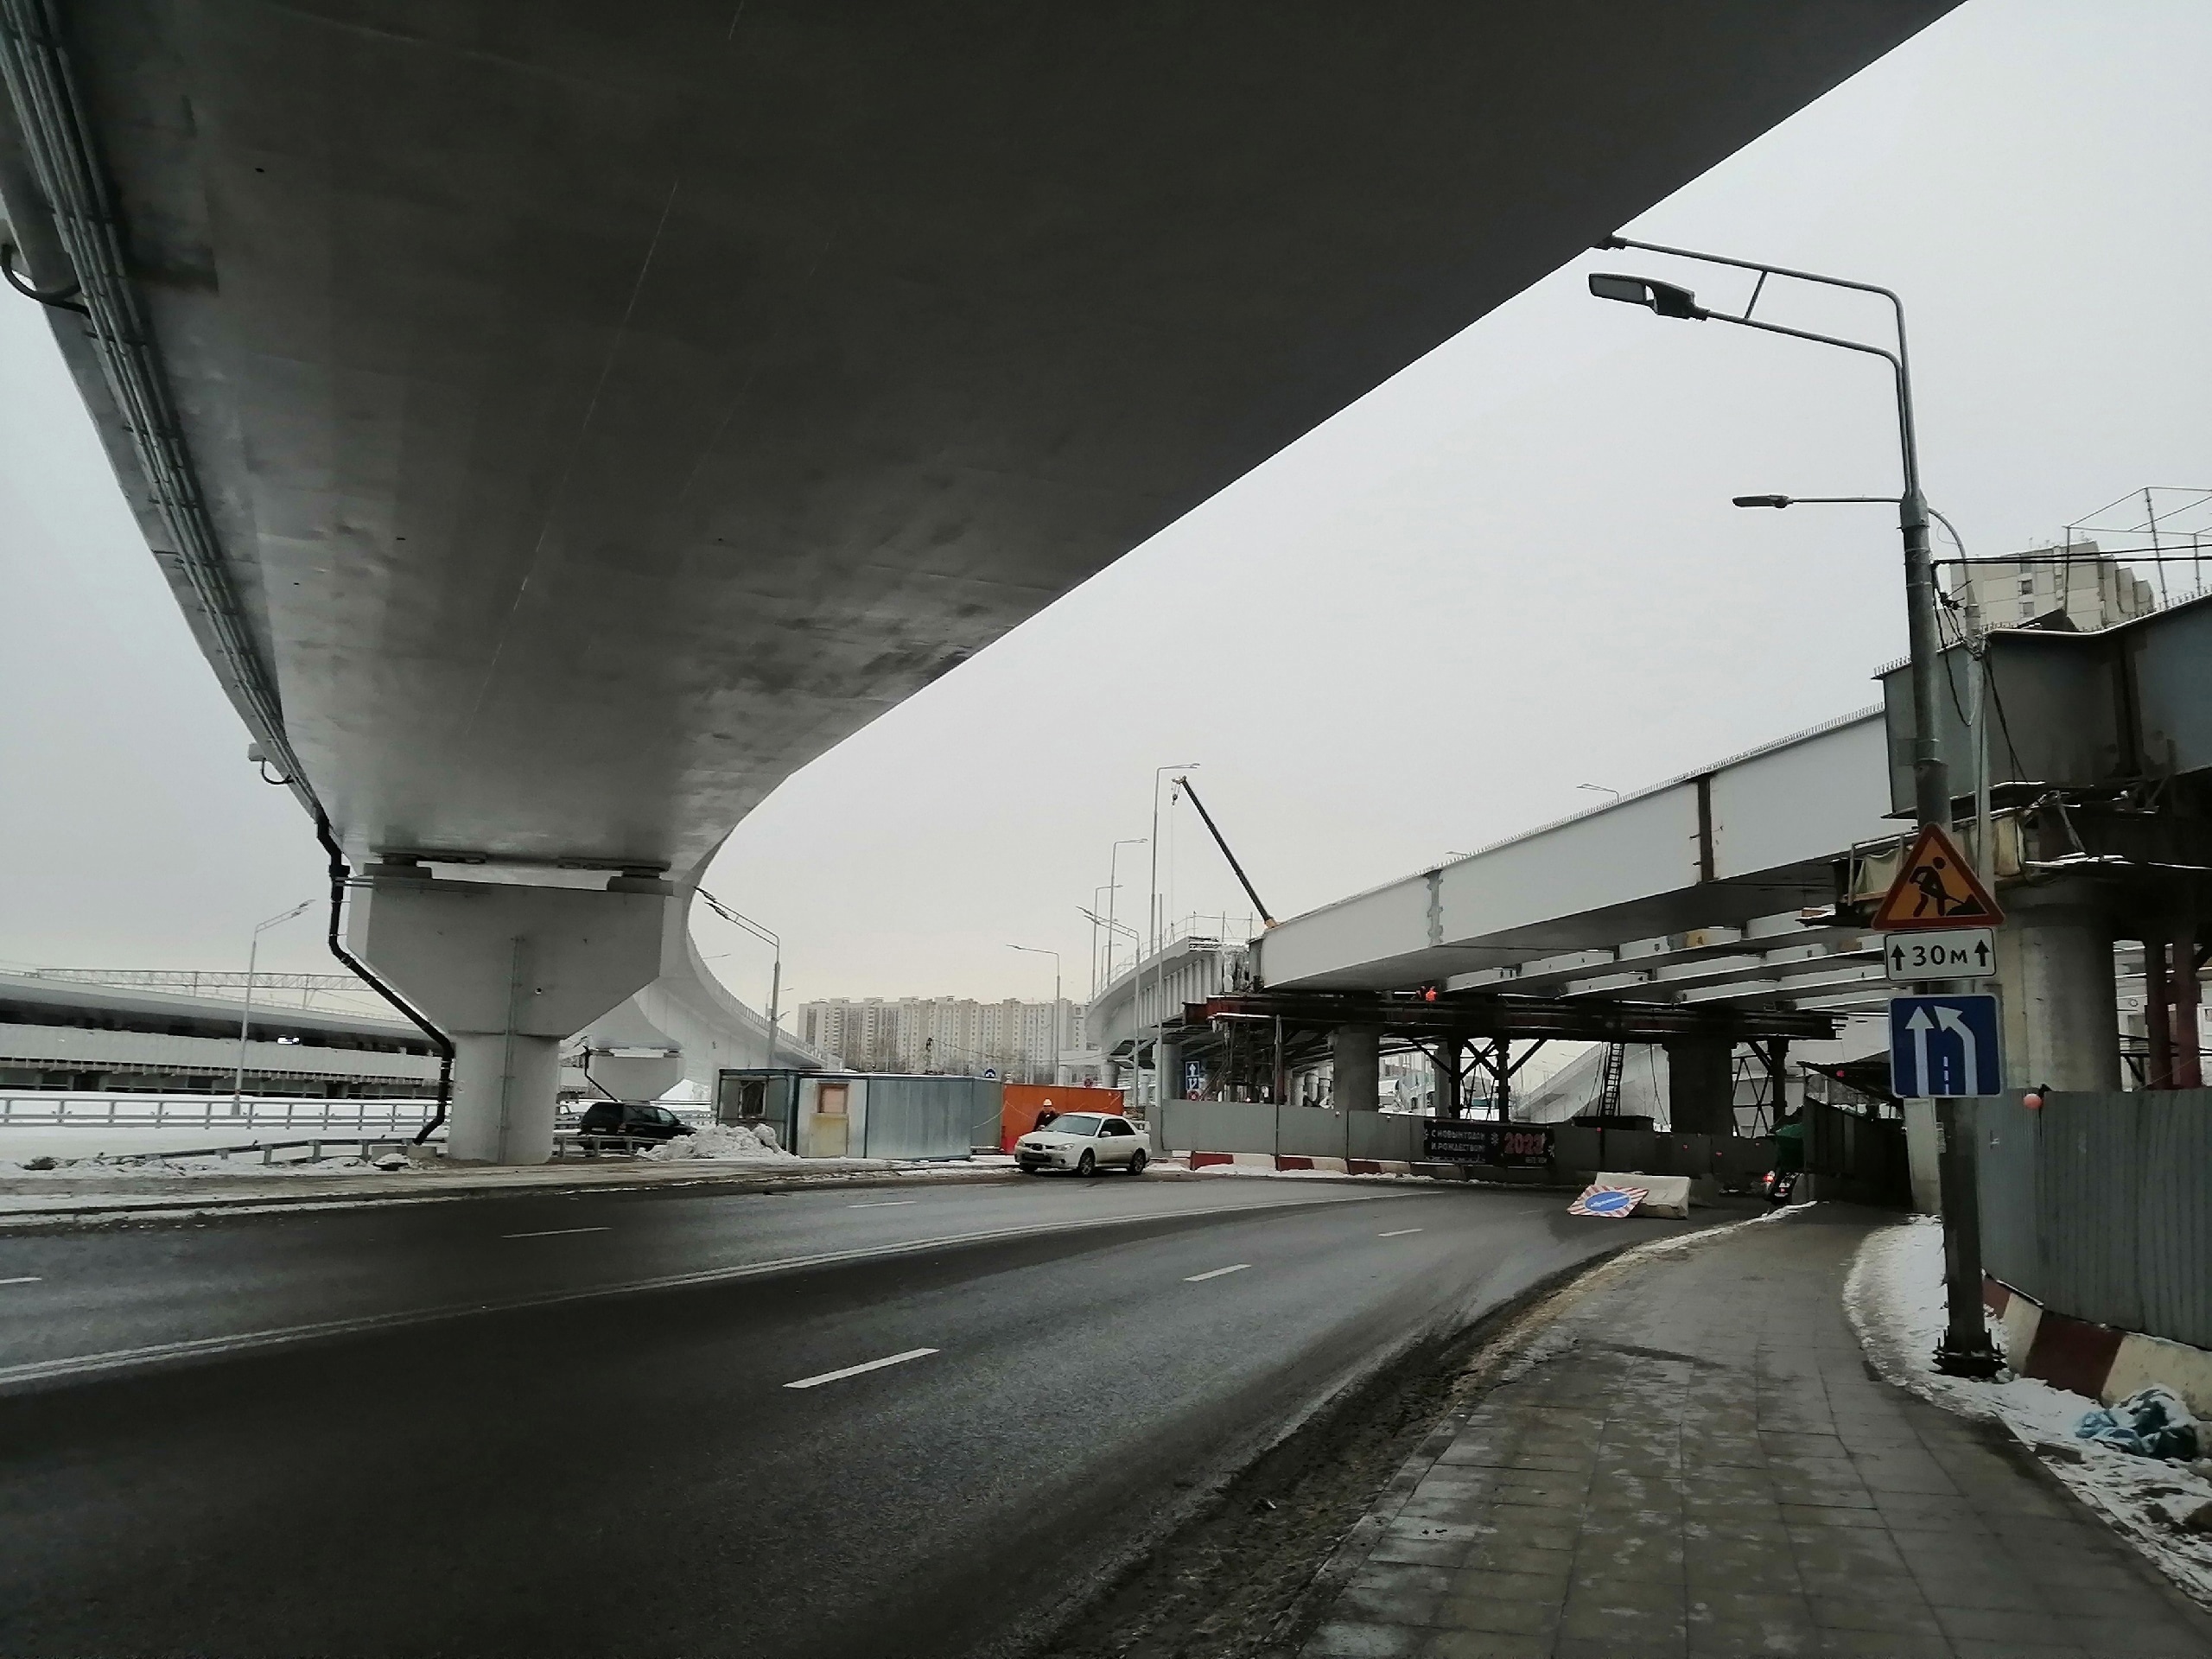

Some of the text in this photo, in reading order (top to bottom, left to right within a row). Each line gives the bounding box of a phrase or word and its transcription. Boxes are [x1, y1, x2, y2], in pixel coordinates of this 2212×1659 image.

[1431, 1129, 1436, 1138] С
[1431, 1141, 1436, 1151] И
[1504, 1132, 1544, 1155] 2023
